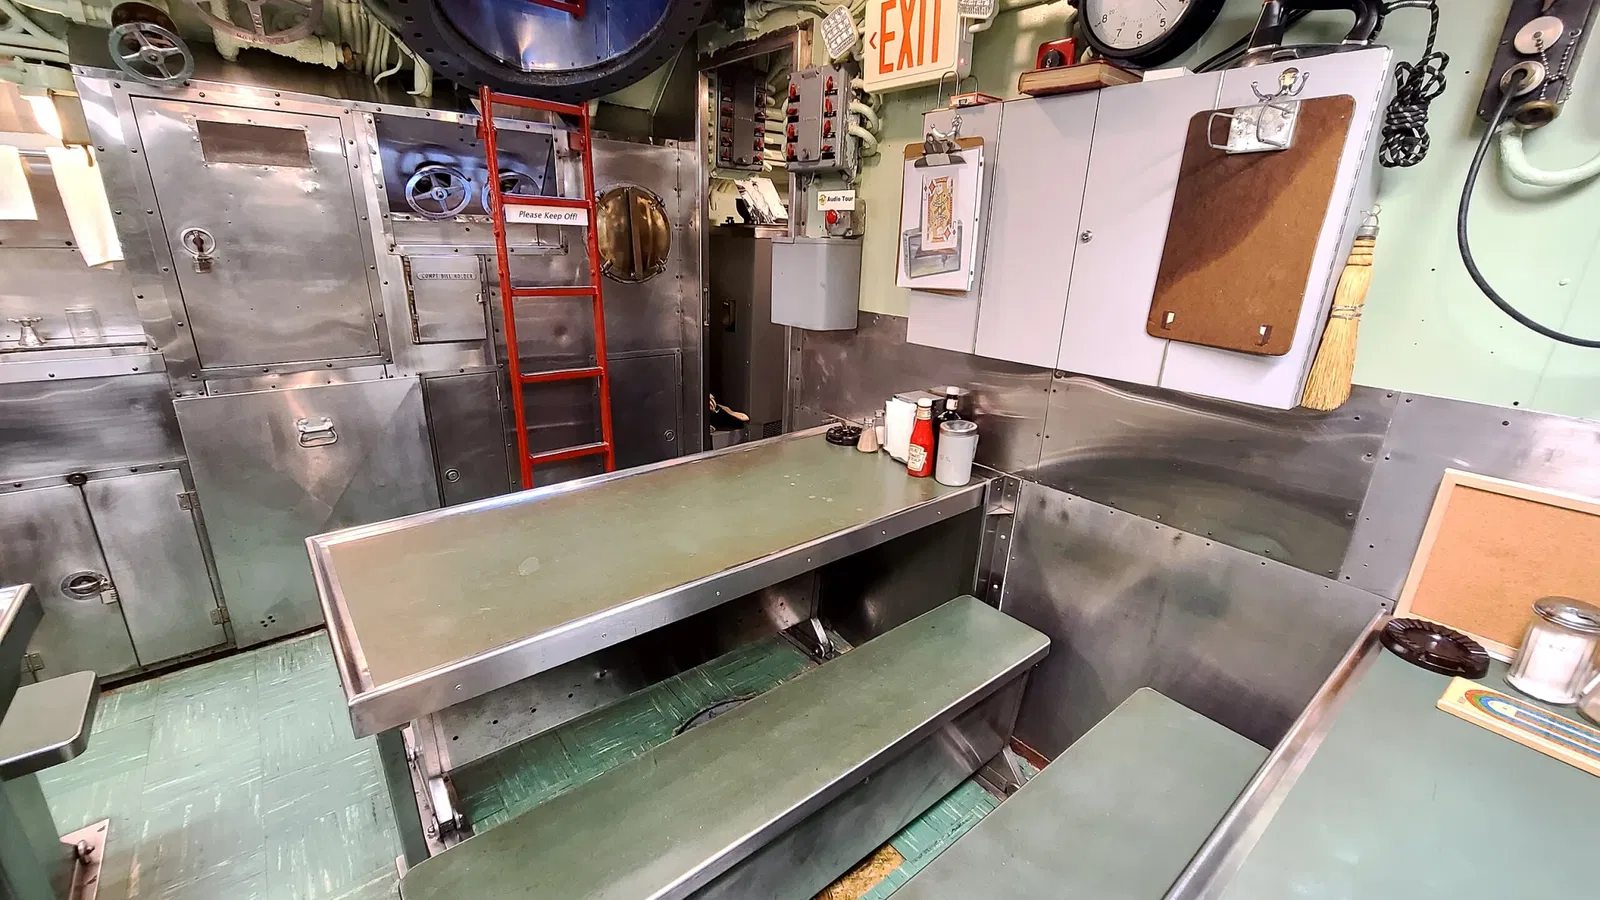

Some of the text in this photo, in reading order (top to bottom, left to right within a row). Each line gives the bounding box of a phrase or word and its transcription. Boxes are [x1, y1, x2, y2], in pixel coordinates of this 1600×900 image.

[1101, 14, 1108, 23] 8
[1159, 18, 1166, 28] 5
[879, 0, 941, 74] EXIT
[1116, 28, 1122, 37] 7
[1136, 30, 1143, 39] 6
[518, 210, 578, 221] Please Keep Off!
